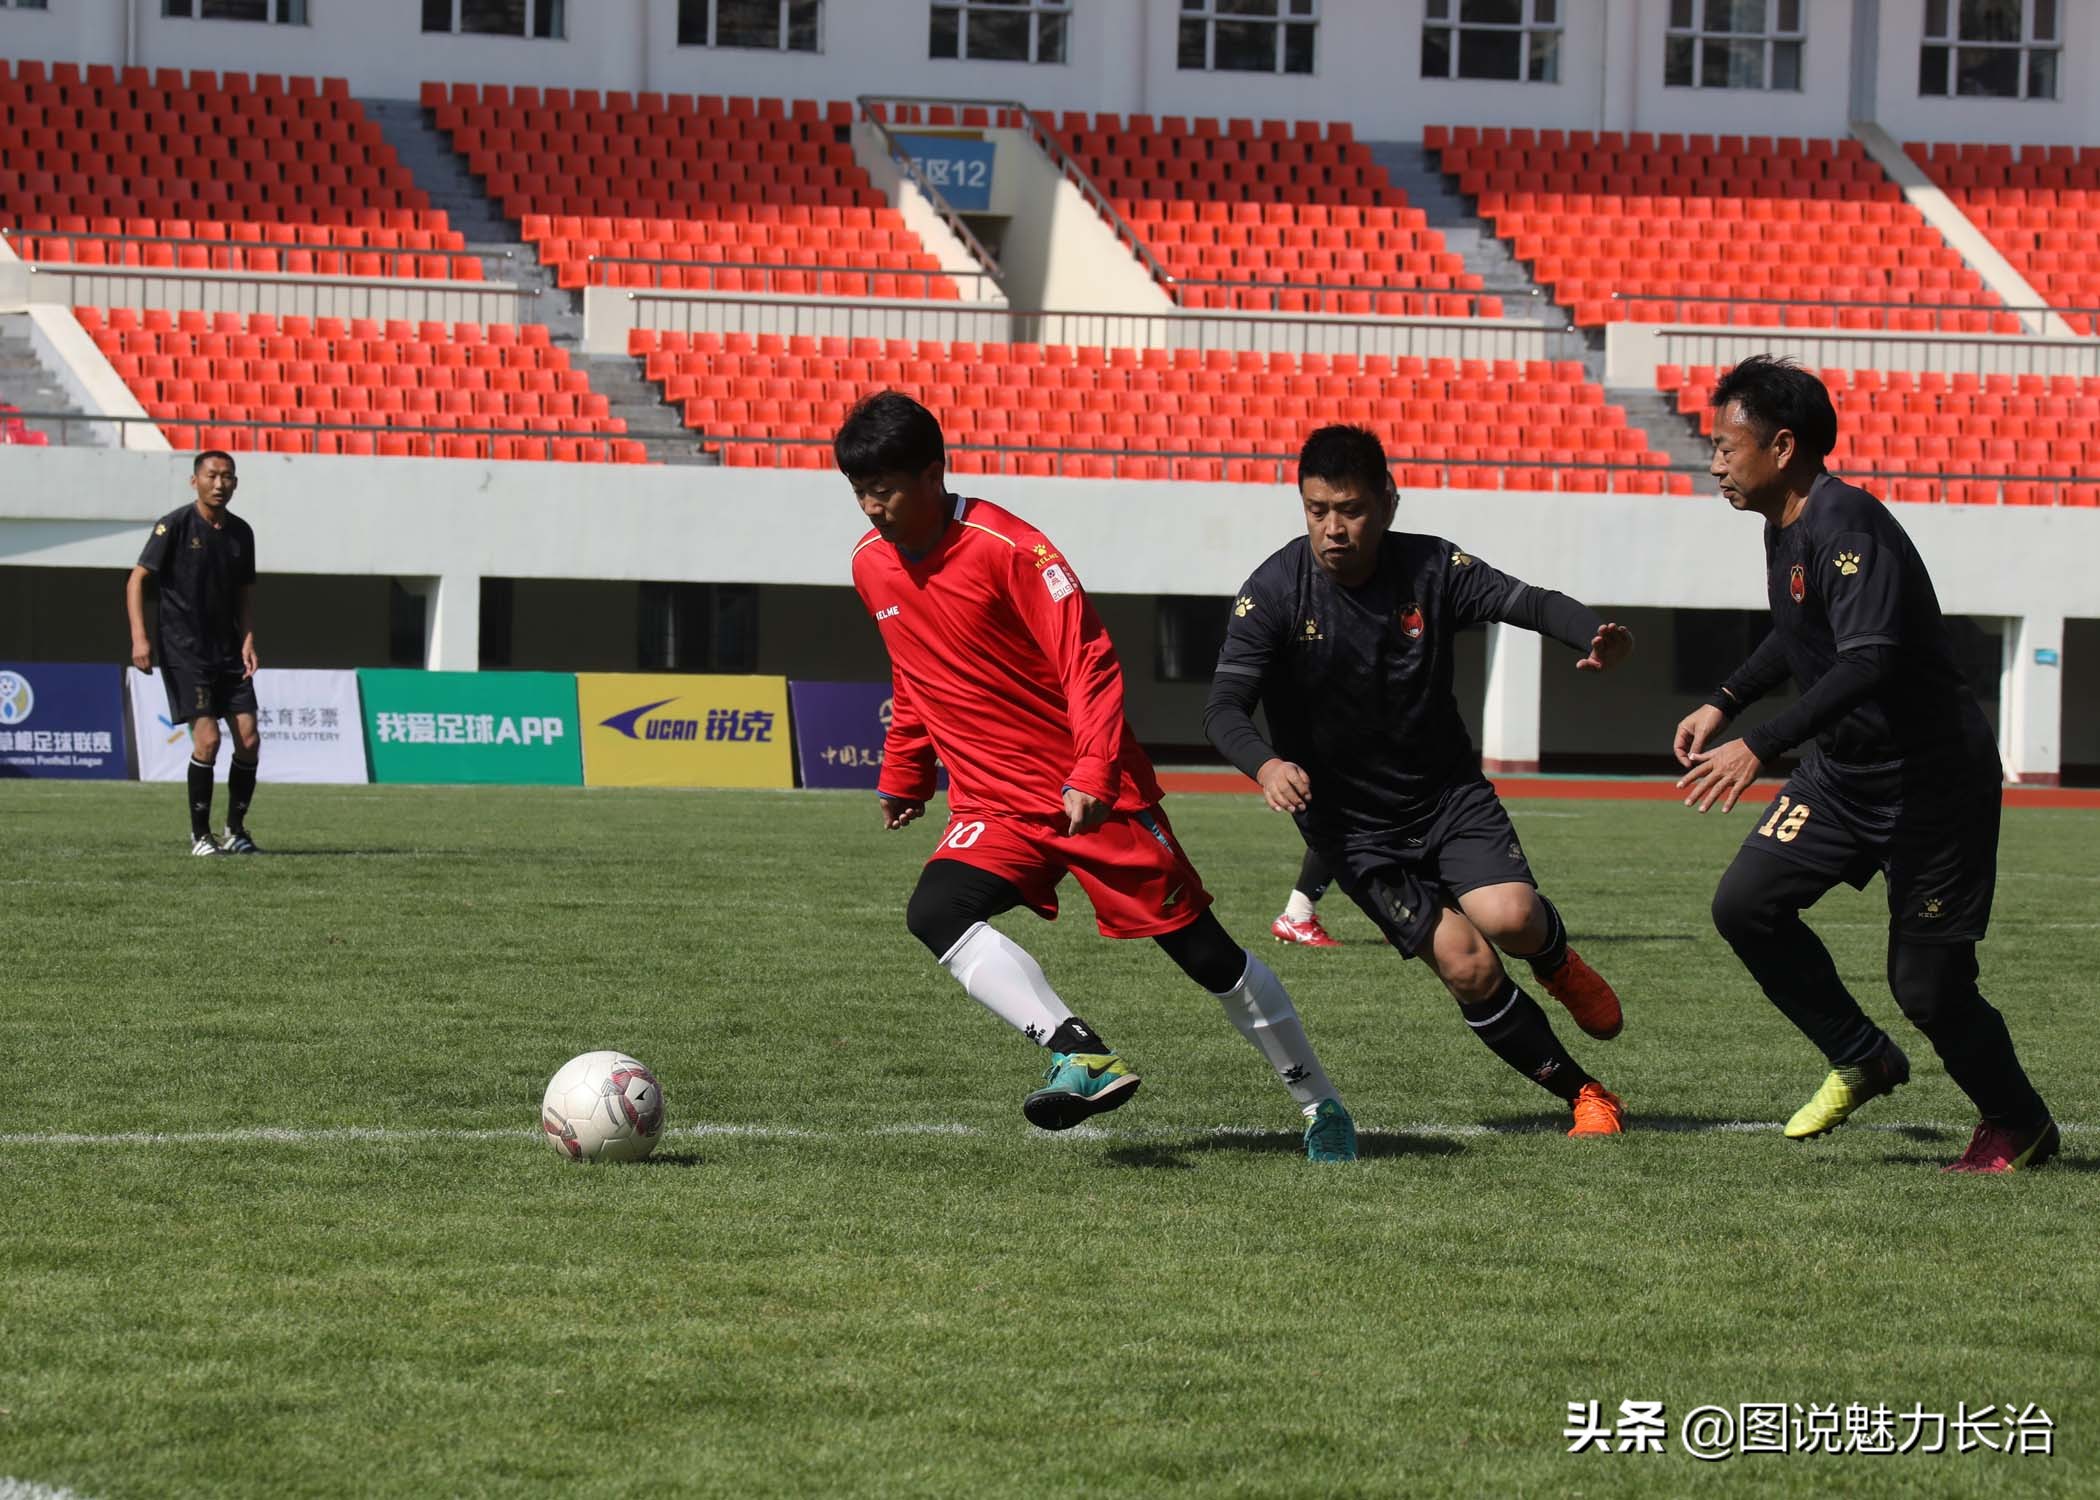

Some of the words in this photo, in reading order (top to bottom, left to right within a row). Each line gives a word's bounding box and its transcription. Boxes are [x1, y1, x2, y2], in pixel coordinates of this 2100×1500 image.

[376, 712, 565, 745] 我爱足球APP
[705, 709, 775, 743] 锐克
[1758, 795, 1810, 842] 18
[936, 821, 985, 853] 10
